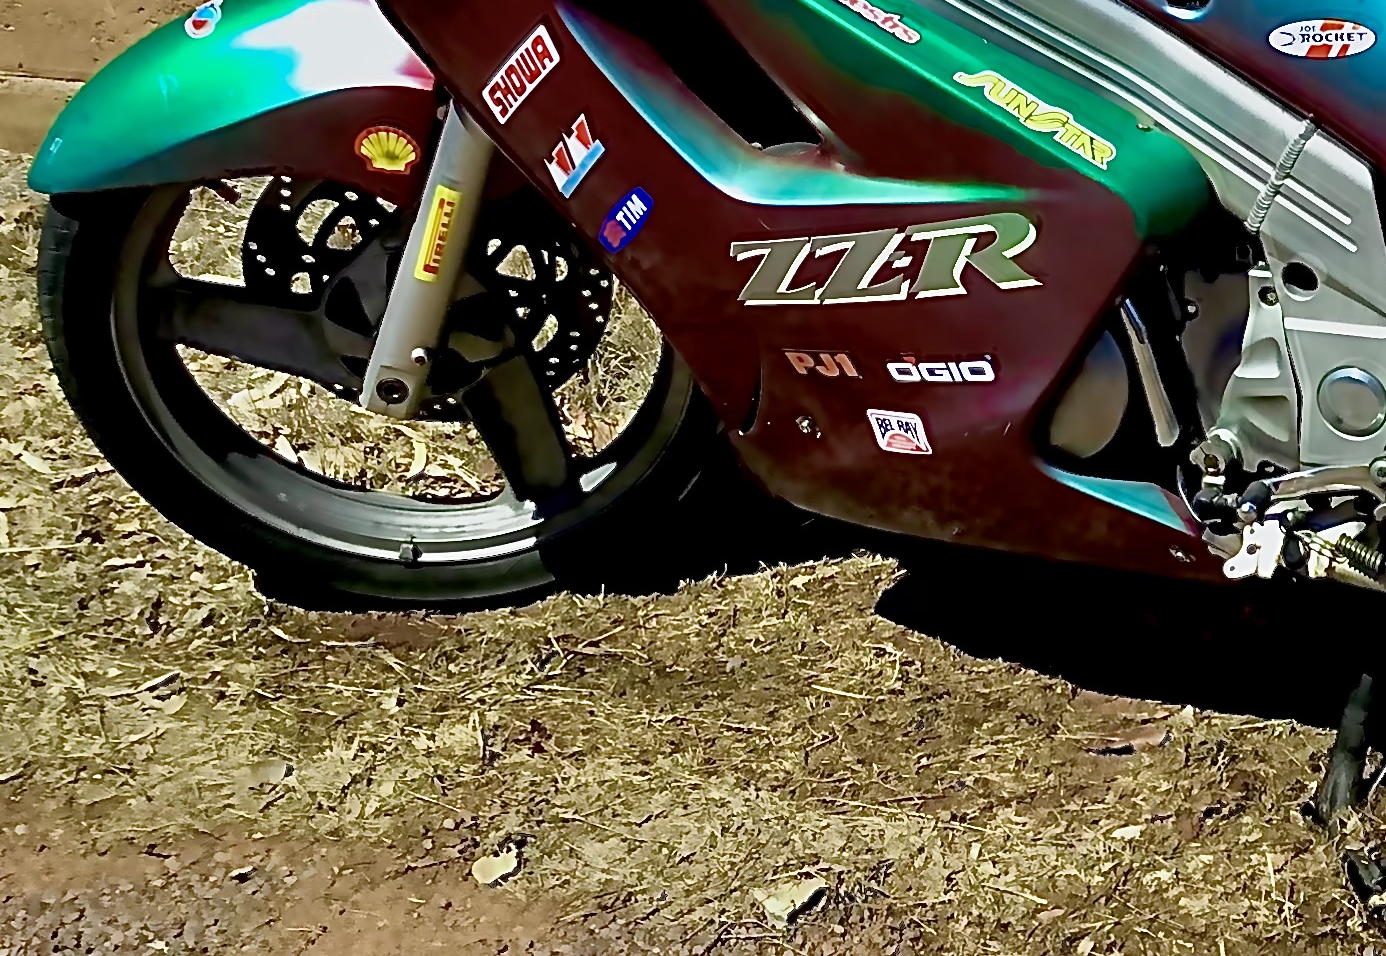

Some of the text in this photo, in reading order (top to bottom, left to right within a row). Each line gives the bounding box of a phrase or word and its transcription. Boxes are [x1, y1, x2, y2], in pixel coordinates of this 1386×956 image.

[1299, 32, 1367, 44] ROCKET
[488, 34, 555, 119] SHOWA
[615, 193, 648, 231] TIM
[423, 197, 456, 275] PIRELLI
[785, 352, 858, 377] PJ1
[886, 358, 995, 382] OGIO
